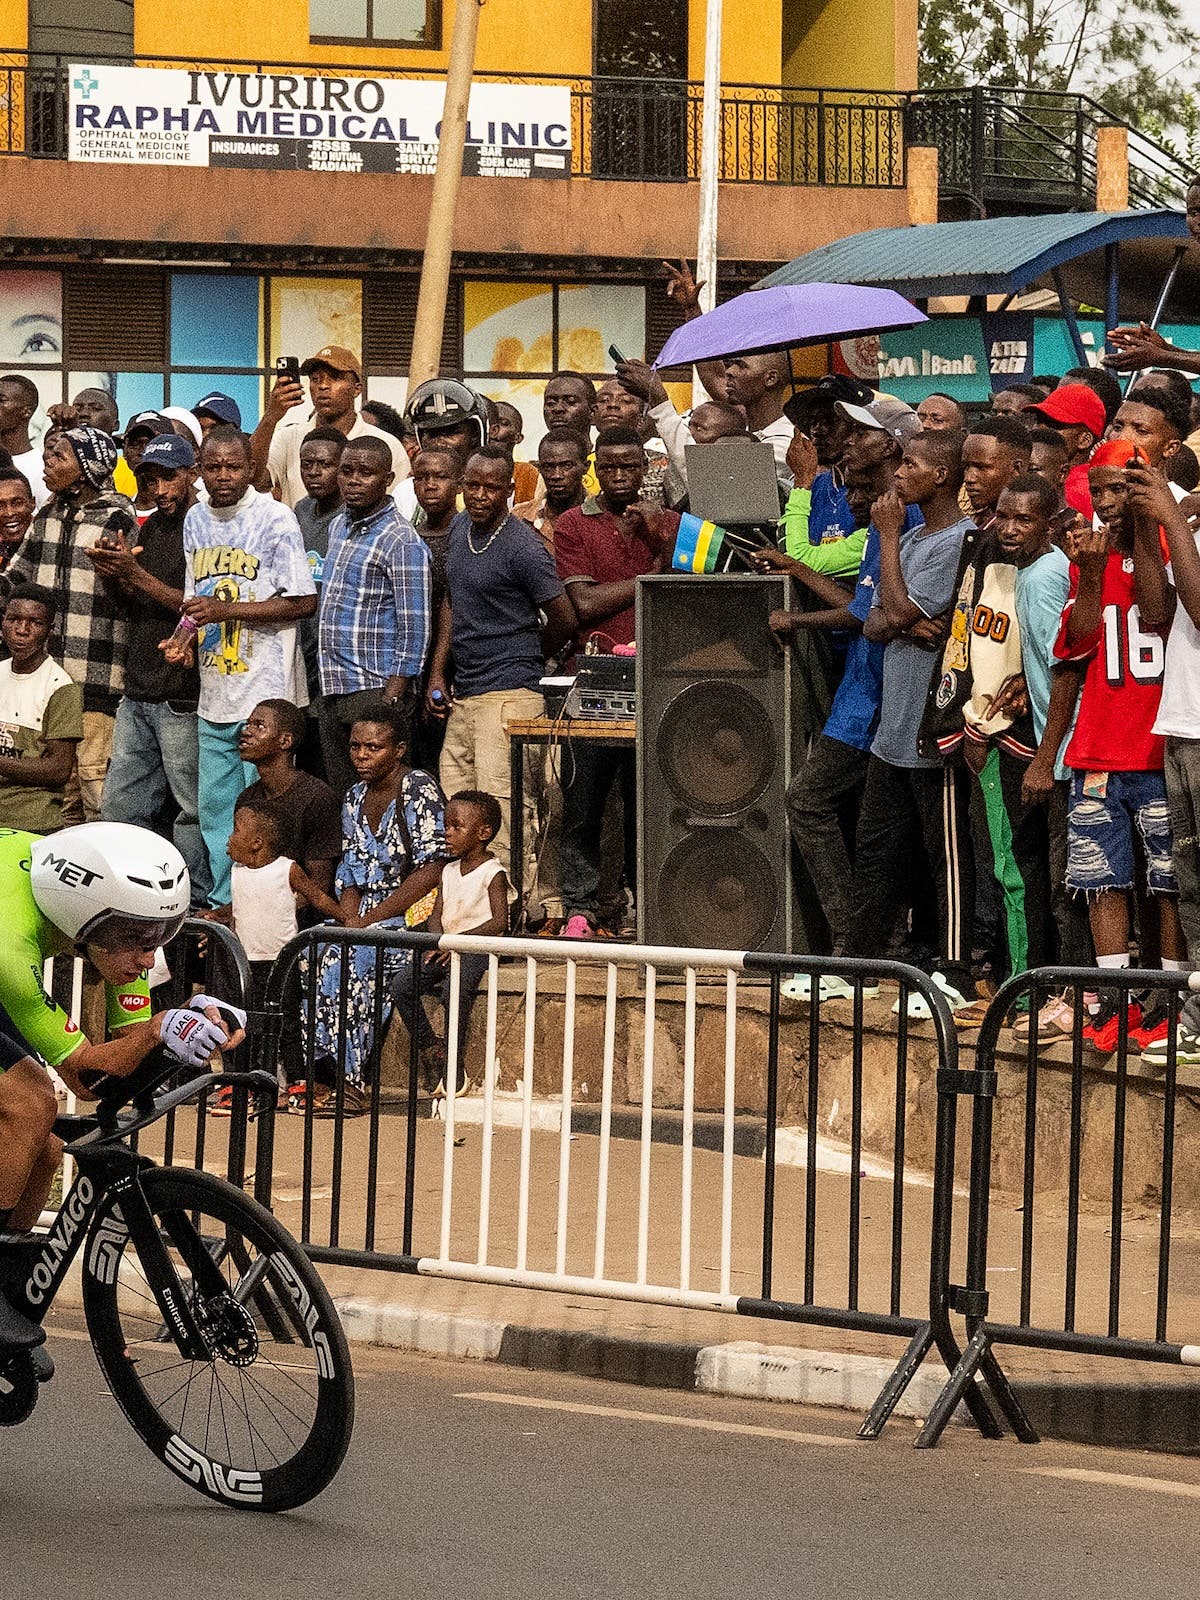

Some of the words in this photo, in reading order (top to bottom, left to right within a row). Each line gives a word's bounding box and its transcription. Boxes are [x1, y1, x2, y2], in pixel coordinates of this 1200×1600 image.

[187, 70, 385, 114] IVURIRO
[75, 104, 221, 133] RAPHA
[237, 110, 420, 142] MEDICAL
[136, 141, 190, 151] MEDICINE
[139, 131, 190, 141] MOLOGY
[137, 151, 191, 161] MEDICINE
[211, 141, 280, 156] INSURANCES
[506, 157, 531, 168] CARE
[932, 353, 978, 375] Bank
[972, 604, 1011, 644] 00
[1102, 603, 1165, 687] 16
[40, 852, 105, 888] MET
[159, 902, 180, 912] MET
[122, 996, 145, 1006] MOL
[172, 1013, 193, 1037] UAE
[25, 1175, 94, 1305] COLNAGO
[161, 1287, 190, 1340] Emirates
